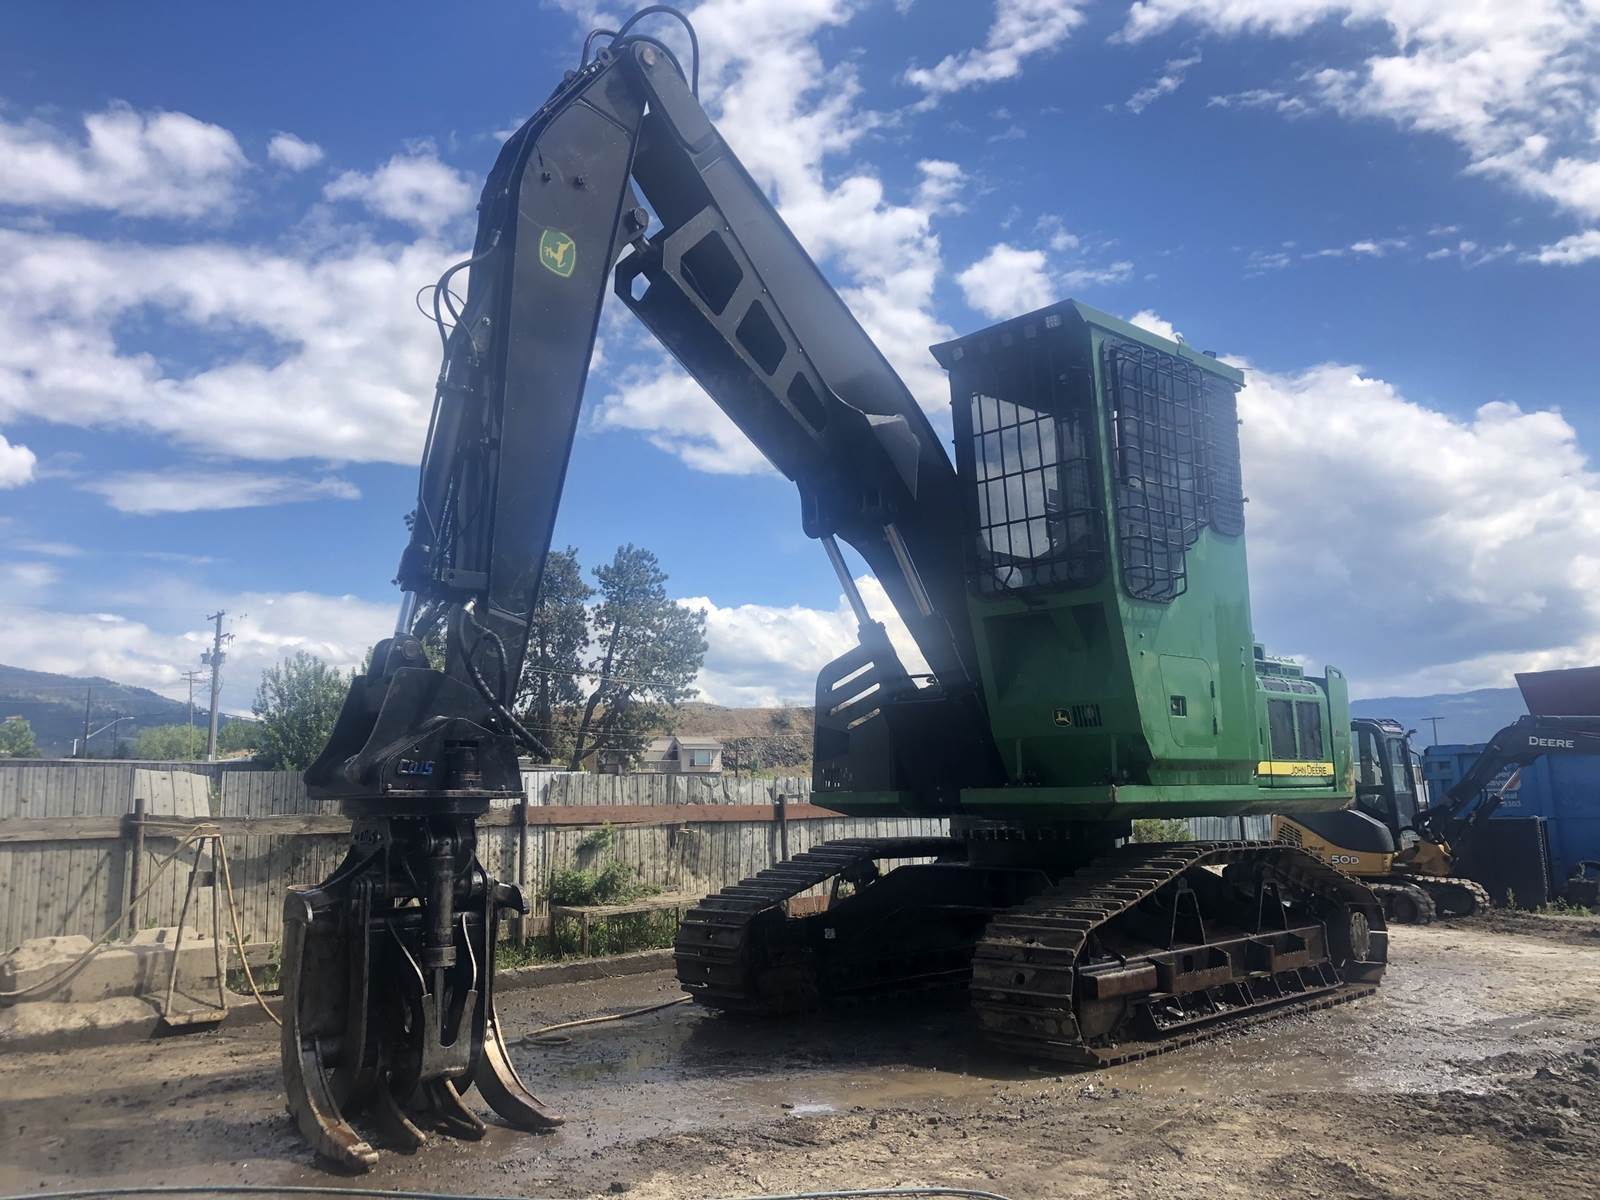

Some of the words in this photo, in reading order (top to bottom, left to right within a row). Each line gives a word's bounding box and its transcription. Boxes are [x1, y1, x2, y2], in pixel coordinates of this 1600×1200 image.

[1528, 735, 1575, 748] DEERE
[1290, 763, 1307, 775] JOHN
[1306, 763, 1328, 775] DEERE
[1331, 855, 1360, 865] 50D
